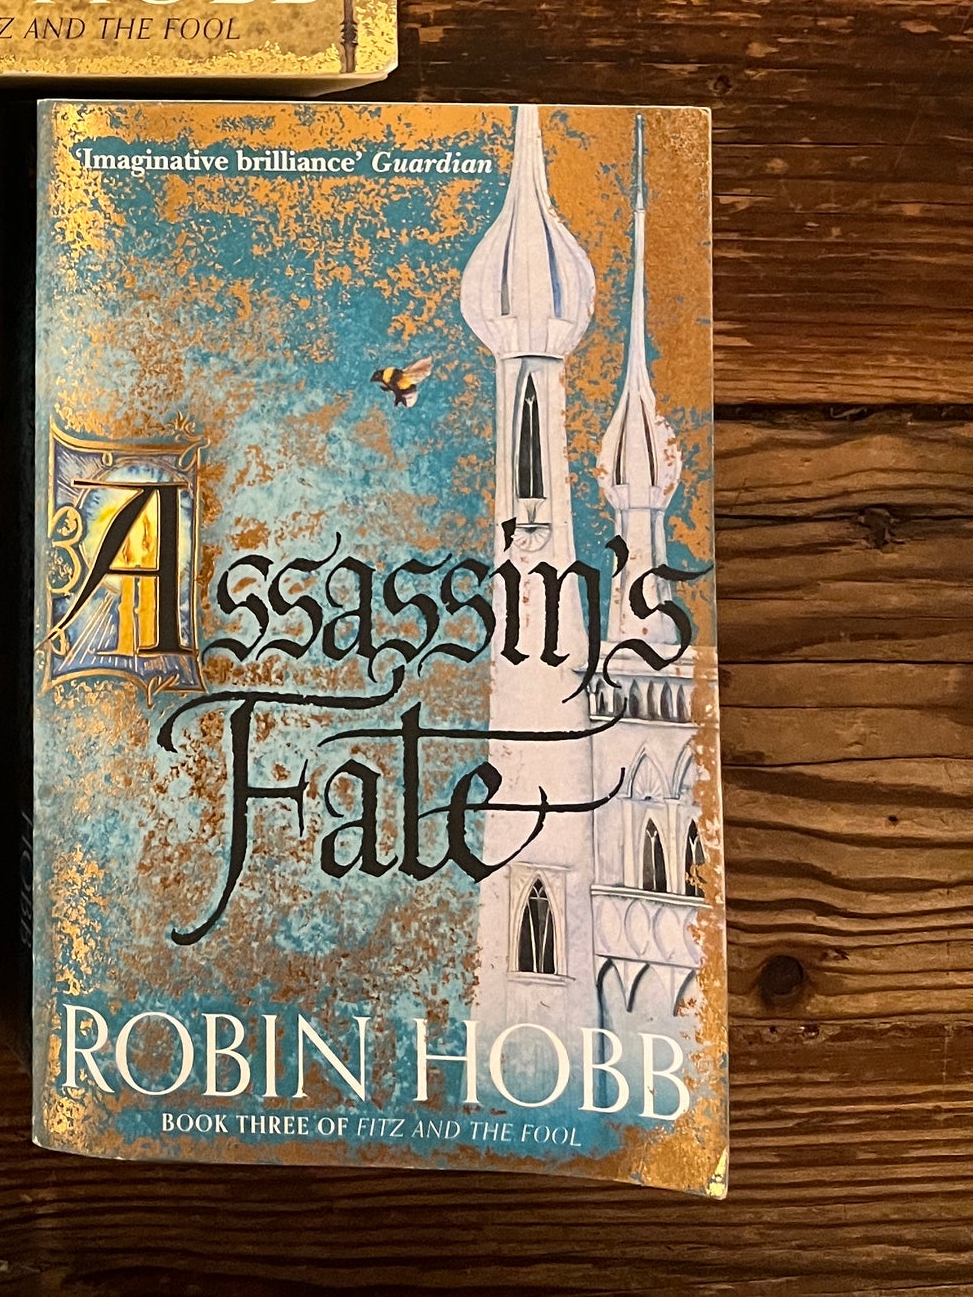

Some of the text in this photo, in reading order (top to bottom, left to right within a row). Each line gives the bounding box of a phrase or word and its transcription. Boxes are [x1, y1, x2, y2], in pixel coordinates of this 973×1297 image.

[23, 17, 86, 40] AND
[98, 17, 153, 40] THE
[163, 17, 241, 40] FOOL
[75, 147, 494, 177] ‘Imaginative brilliance’ Guardian
[44, 480, 714, 703] Assassin’s
[156, 665, 627, 946] Fate
[62, 1003, 691, 1122] ROBIN HOBB
[162, 1113, 582, 1147] BOOK THREE OF FITZ AND THE FOOL
